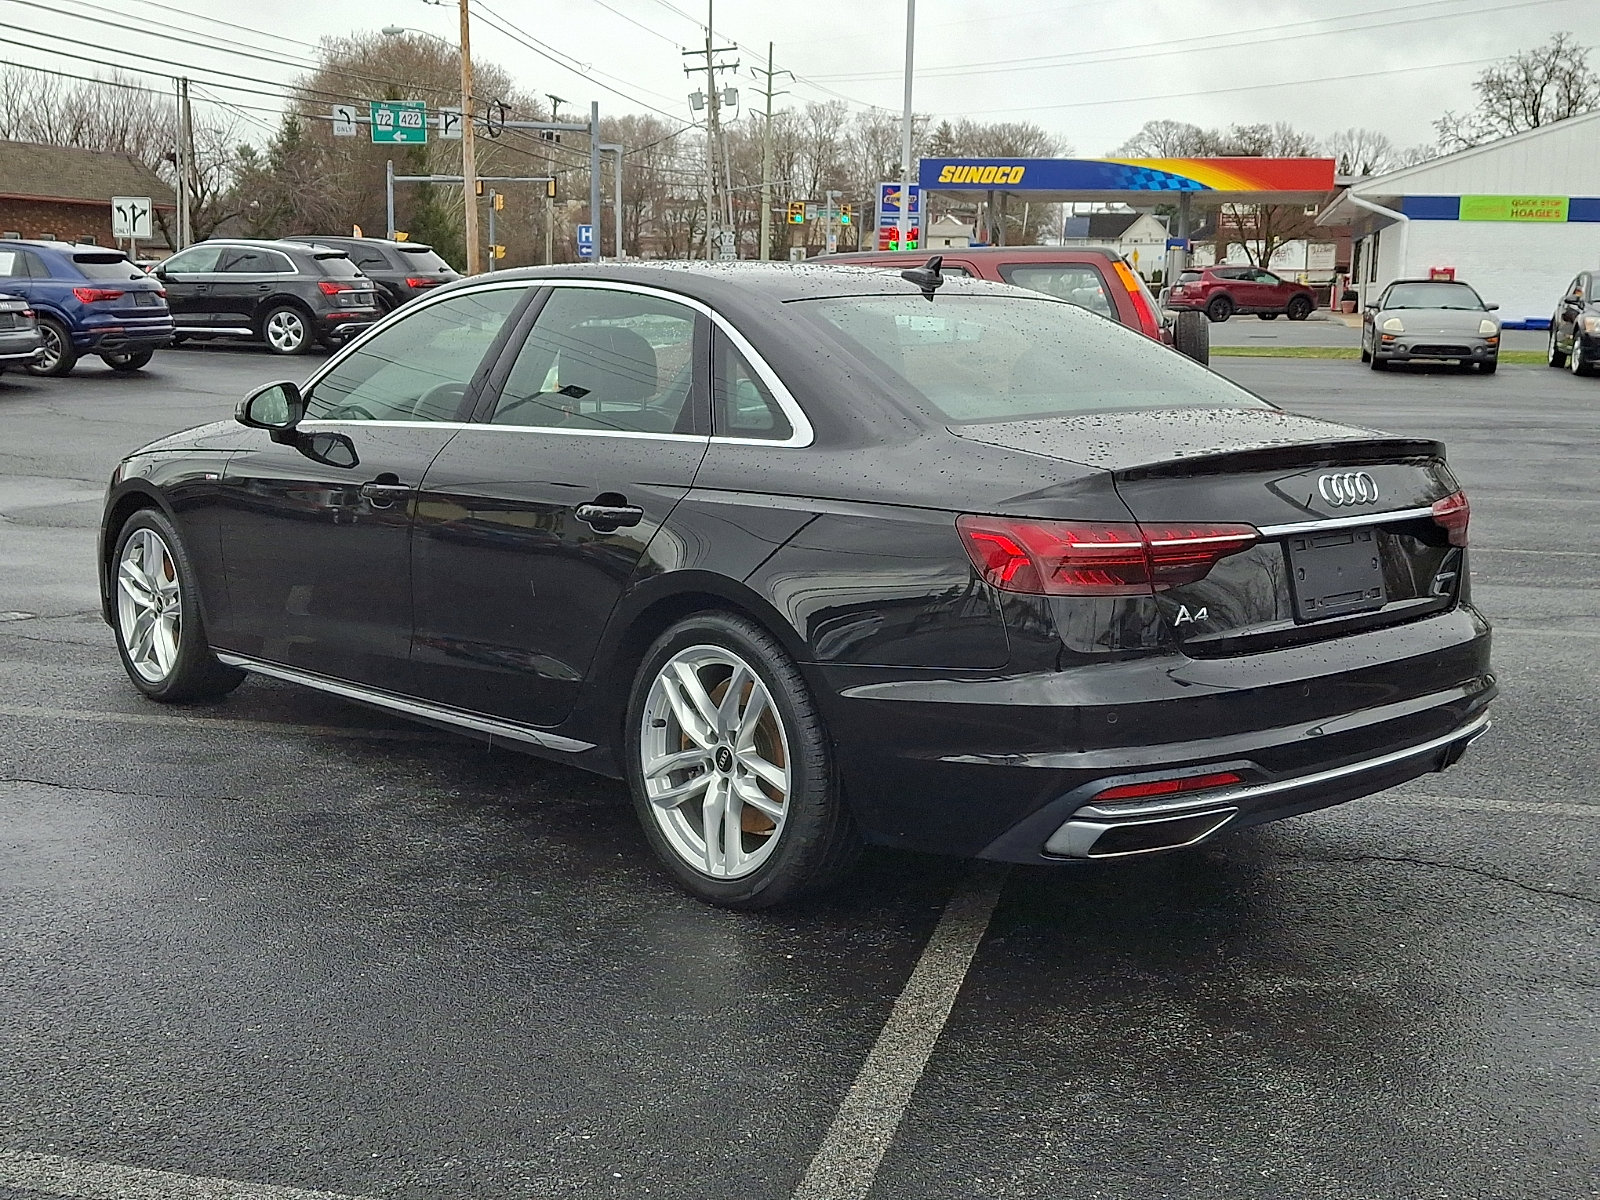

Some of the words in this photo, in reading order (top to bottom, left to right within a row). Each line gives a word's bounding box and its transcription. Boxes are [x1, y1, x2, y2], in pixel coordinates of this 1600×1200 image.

[377, 114, 391, 126] 72
[401, 113, 420, 125] 422
[938, 165, 1026, 185] SUNOCO
[1510, 209, 1561, 218] HOAGIES
[581, 227, 592, 242] H
[722, 234, 733, 244] 72
[1174, 604, 1209, 627] A4
